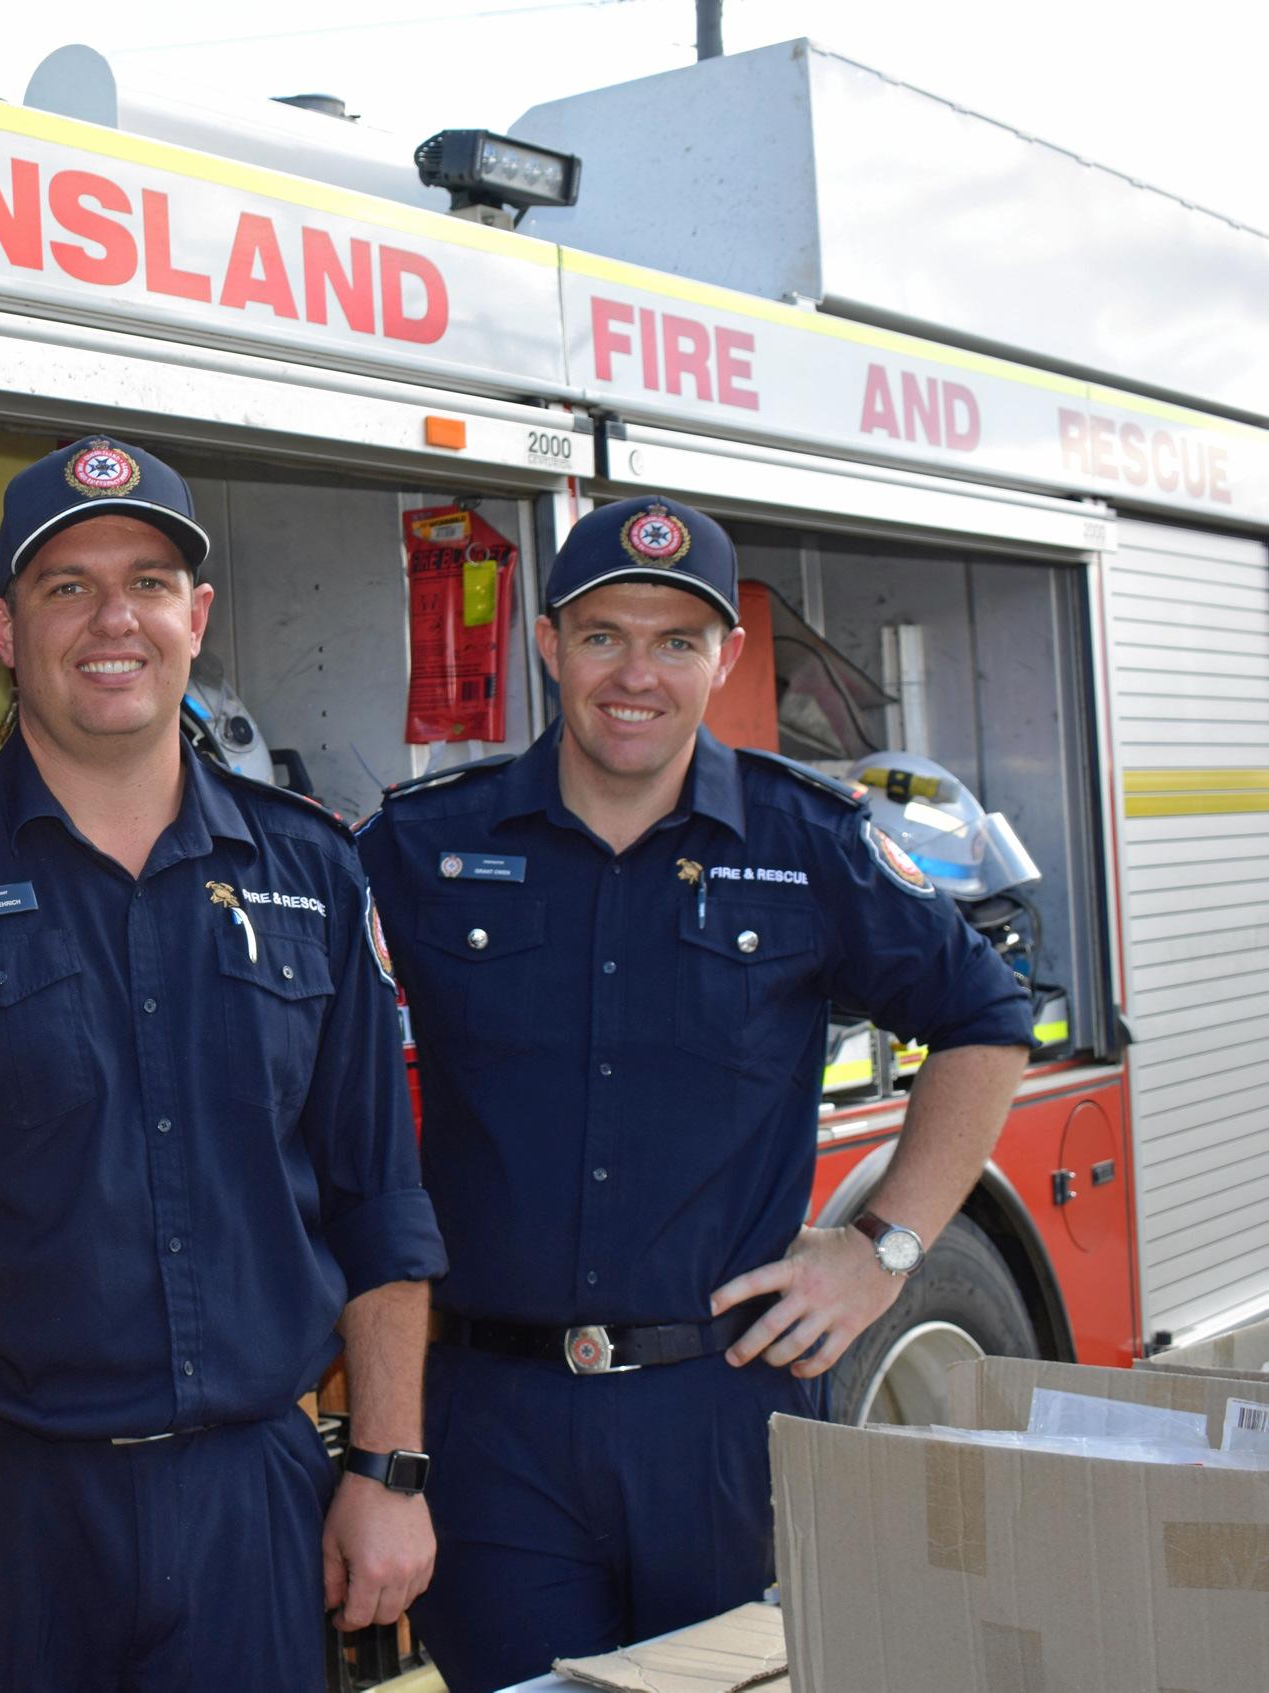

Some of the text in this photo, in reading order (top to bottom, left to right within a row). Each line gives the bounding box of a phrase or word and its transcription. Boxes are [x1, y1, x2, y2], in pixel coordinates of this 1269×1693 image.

[590, 295, 1233, 505] FIRE AND RESCUE
[528, 431, 572, 459] 2000
[710, 866, 809, 885] FIRE & RESCUE
[272, 892, 283, 905] &
